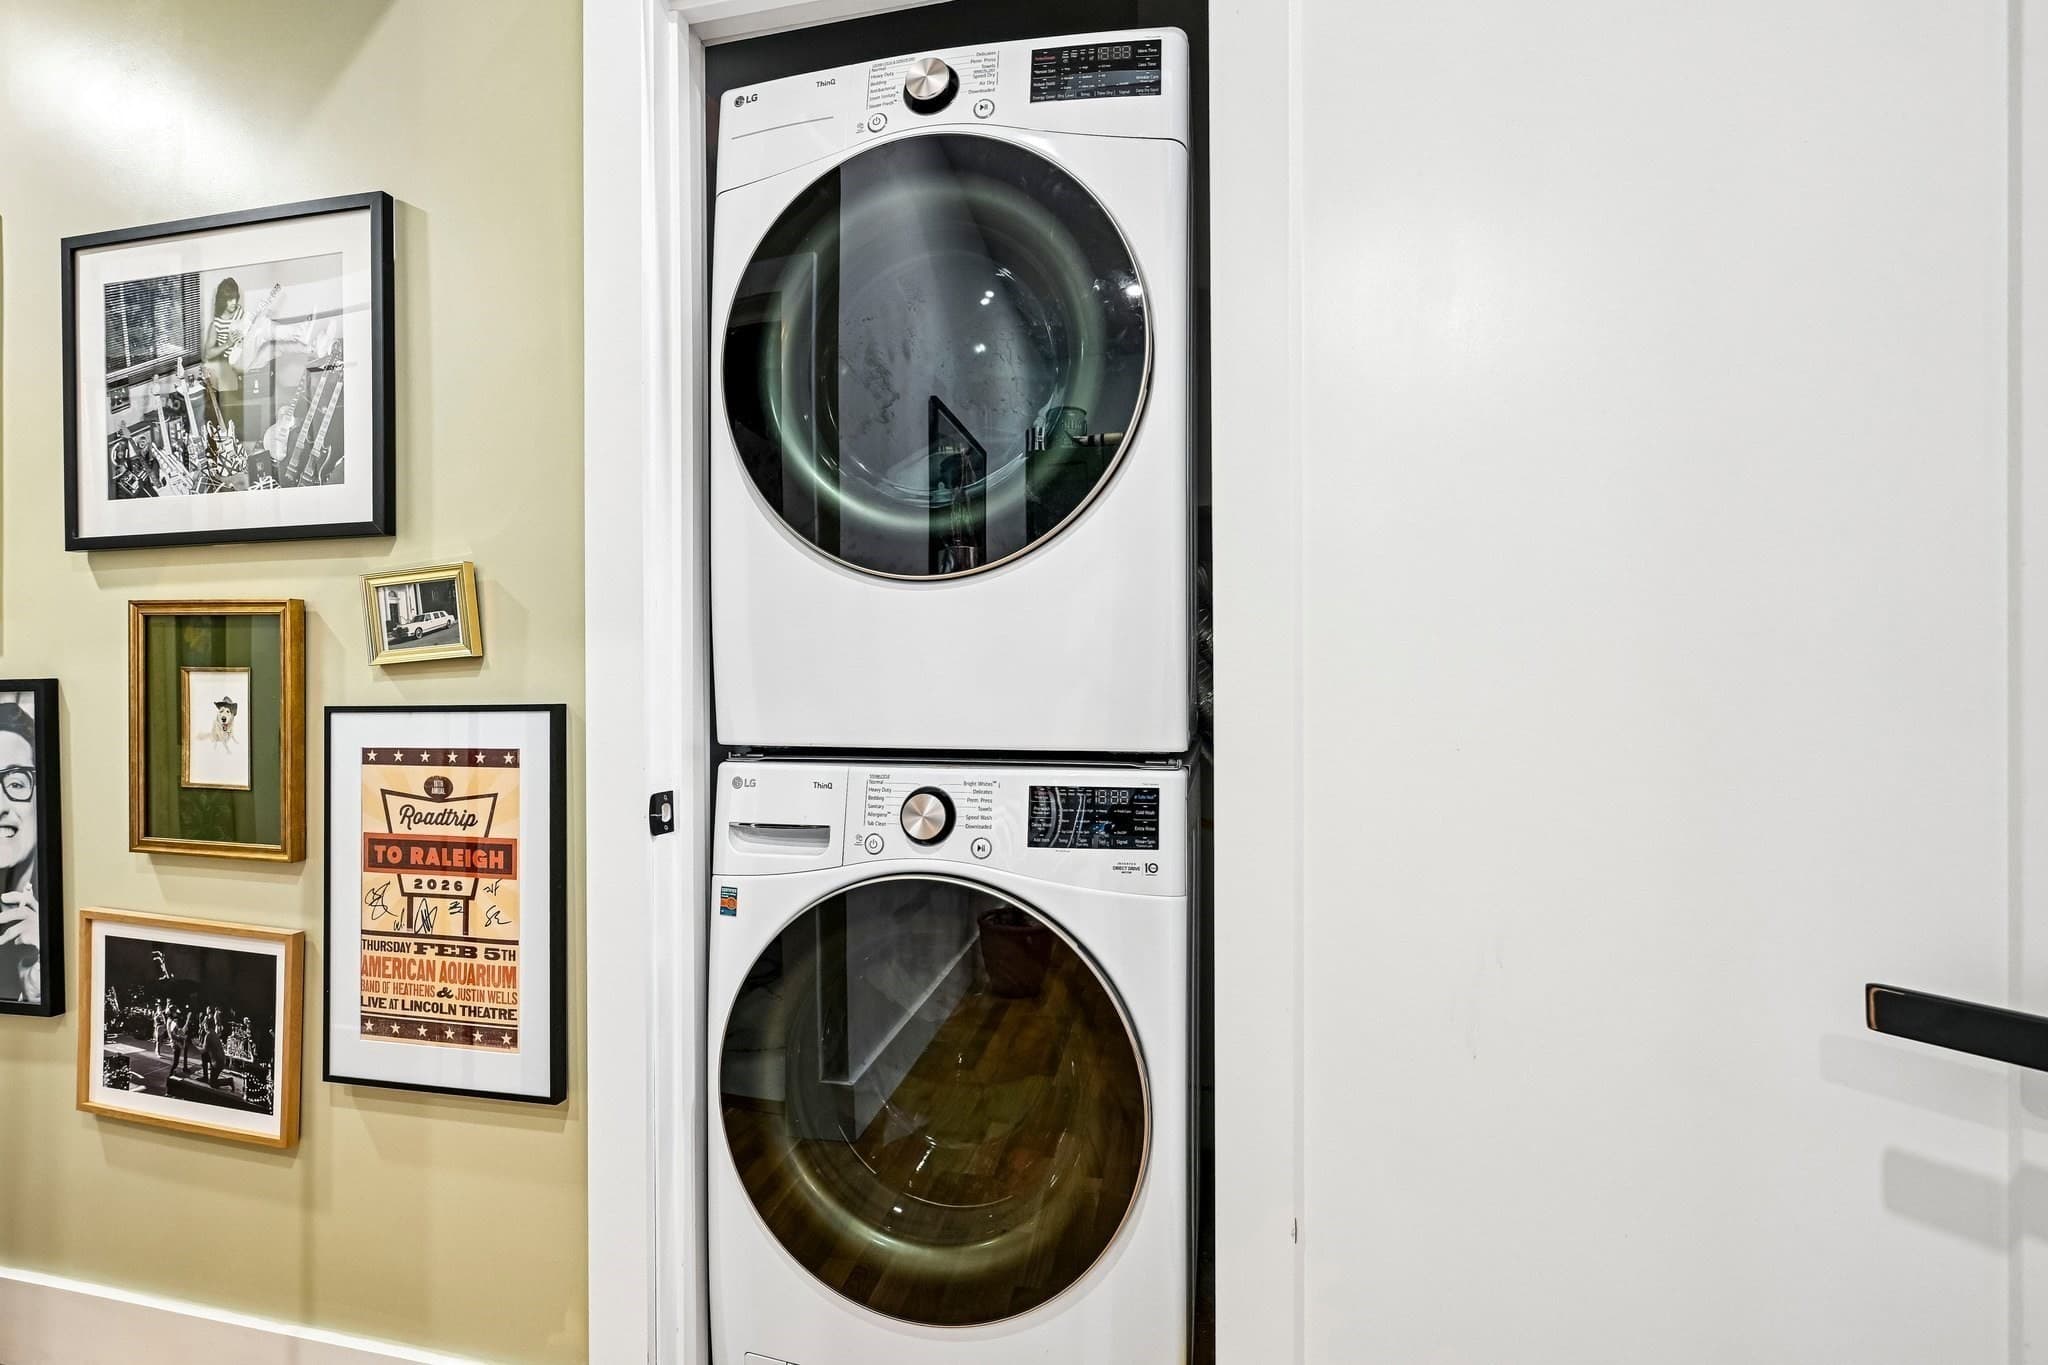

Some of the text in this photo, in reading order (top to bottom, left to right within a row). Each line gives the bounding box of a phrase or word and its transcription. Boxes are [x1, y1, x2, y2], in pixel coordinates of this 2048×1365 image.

[816, 79, 836, 88] ThinQ
[746, 94, 758, 103] LG
[744, 778, 757, 788] LG
[813, 781, 833, 790] ThinQ
[399, 804, 479, 831] Roadtrip
[374, 845, 504, 870] TO RALEIGH
[413, 878, 464, 892] 2026
[362, 939, 516, 962] THURSDAY FEB 5TH
[361, 954, 517, 990] AMERICAN AQUARIUM
[361, 980, 518, 1006] BAND OF HEATHENS & JUSTIN WELLS
[361, 995, 518, 1022] LIVE AT LINCOLN THEATRE
